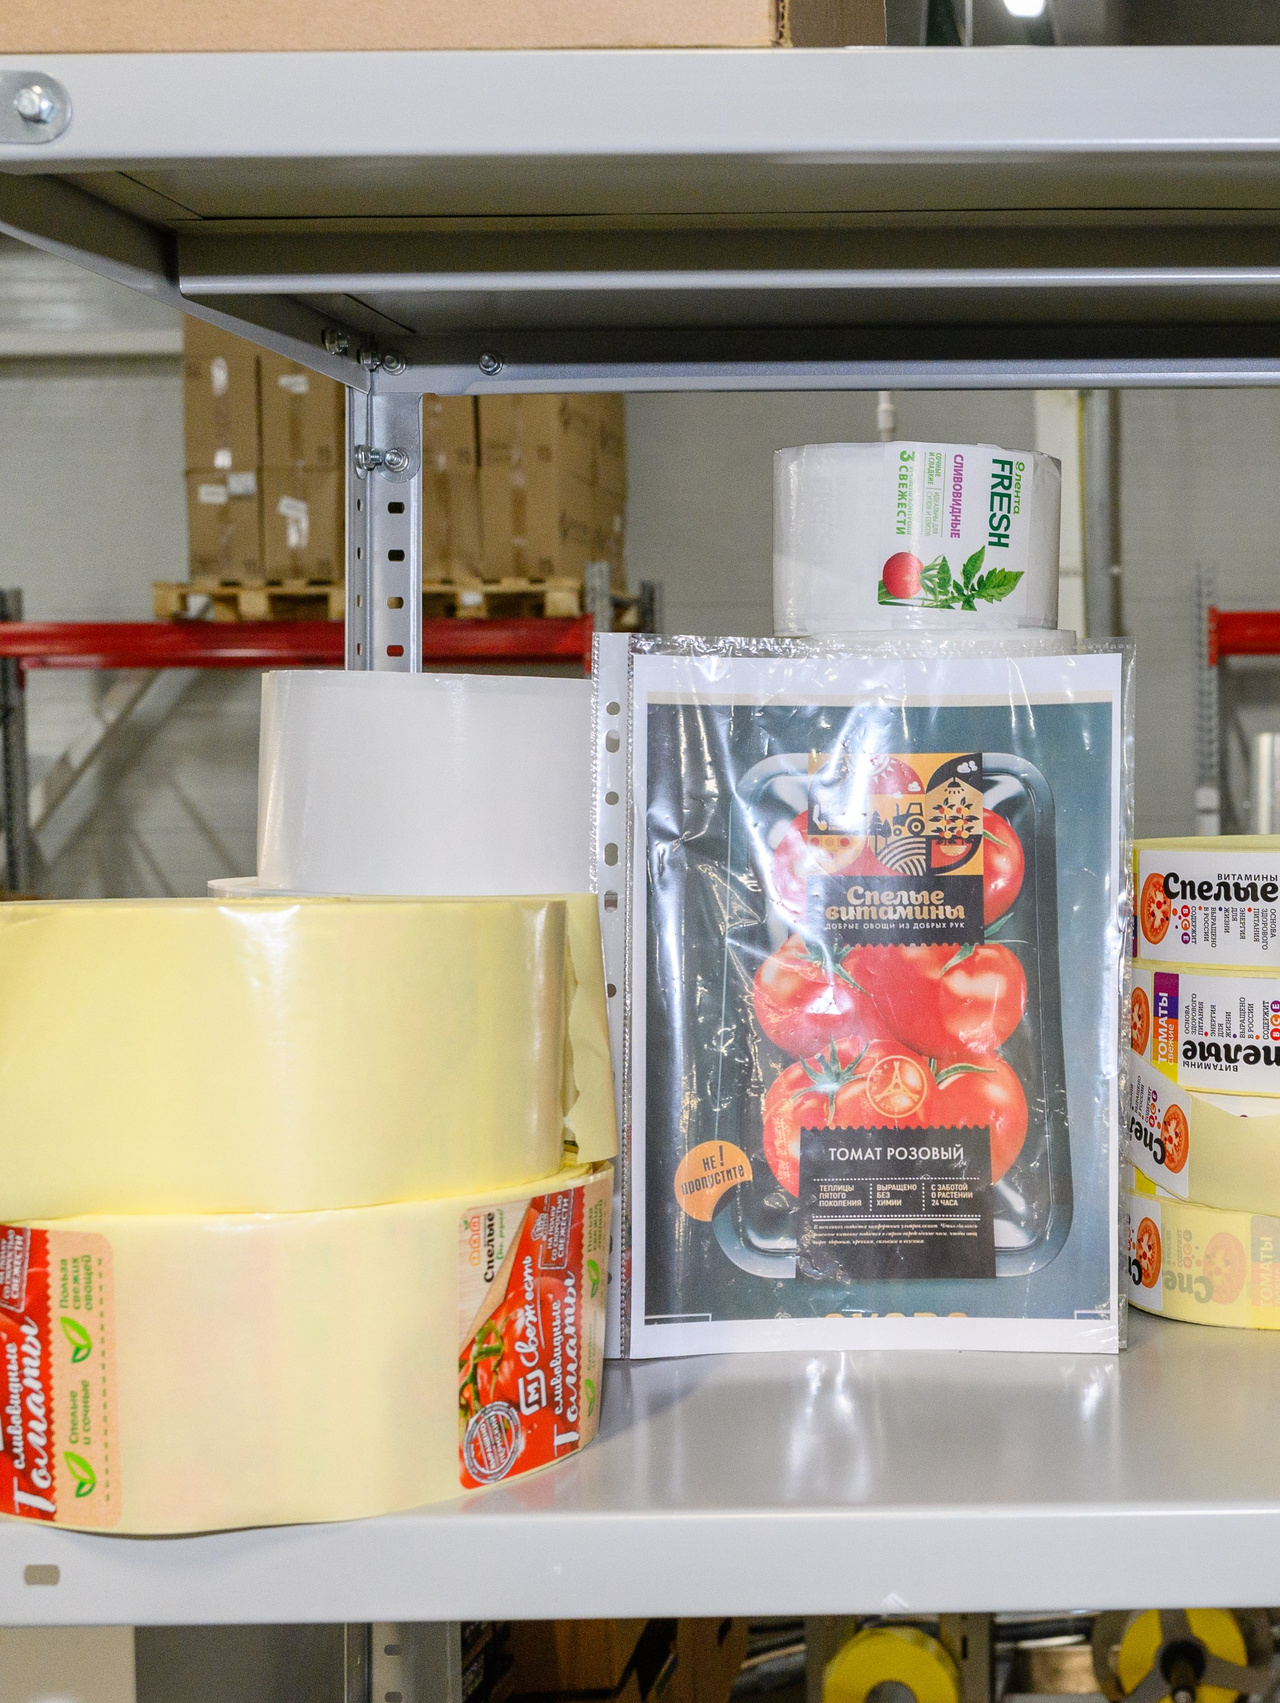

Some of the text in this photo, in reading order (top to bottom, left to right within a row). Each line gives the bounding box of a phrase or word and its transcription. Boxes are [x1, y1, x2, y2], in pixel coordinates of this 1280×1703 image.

[899, 450, 915, 462] 3
[934, 452, 942, 477] СОЧНЫЕ
[927, 460, 935, 485] СЛАДКИЕ
[896, 465, 908, 535] СВЕЖЕСТИ
[949, 454, 964, 539] СЛИВОВИДНЫЕ
[988, 458, 1014, 548] FRESH
[1163, 872, 1279, 903] Спелые
[1217, 873, 1278, 882] ВИТАМИНЫ
[847, 885, 945, 905] Спелые
[825, 905, 966, 920] витамины
[1269, 908, 1277, 939] ОСНОВА
[863, 922, 895, 930] ОВОЩИ
[899, 922, 910, 930] ИЗ
[913, 922, 947, 930] ДОБРЫХ
[950, 922, 966, 930] РУК
[1157, 992, 1168, 1065] ТОМАТЫ
[1183, 1061, 1238, 1072] ВИТАМИНЫ
[828, 1144, 964, 1160] ТОМАТ РОЗОВЫЙ
[819, 1184, 855, 1193] ТЕПЛИЦЫ
[819, 1192, 847, 1200] ПЯТОГО
[876, 1184, 917, 1192] ВЫРАЩЕНО
[876, 1192, 891, 1200] БЕЗ
[937, 1182, 968, 1191] ЗАБОТОЙ
[819, 1200, 862, 1208] ПОКОЛЕНИЯ
[557, 1198, 570, 1259] СВЕЖЕСТИ
[484, 1212, 496, 1283] Спелые
[514, 1254, 539, 1368] Свежесть
[550, 1299, 563, 1416] сливовидные
[553, 1270, 579, 1458] Томаты
[5, 1342, 25, 1470] сливовидные
[13, 1316, 56, 1513] Томаты
